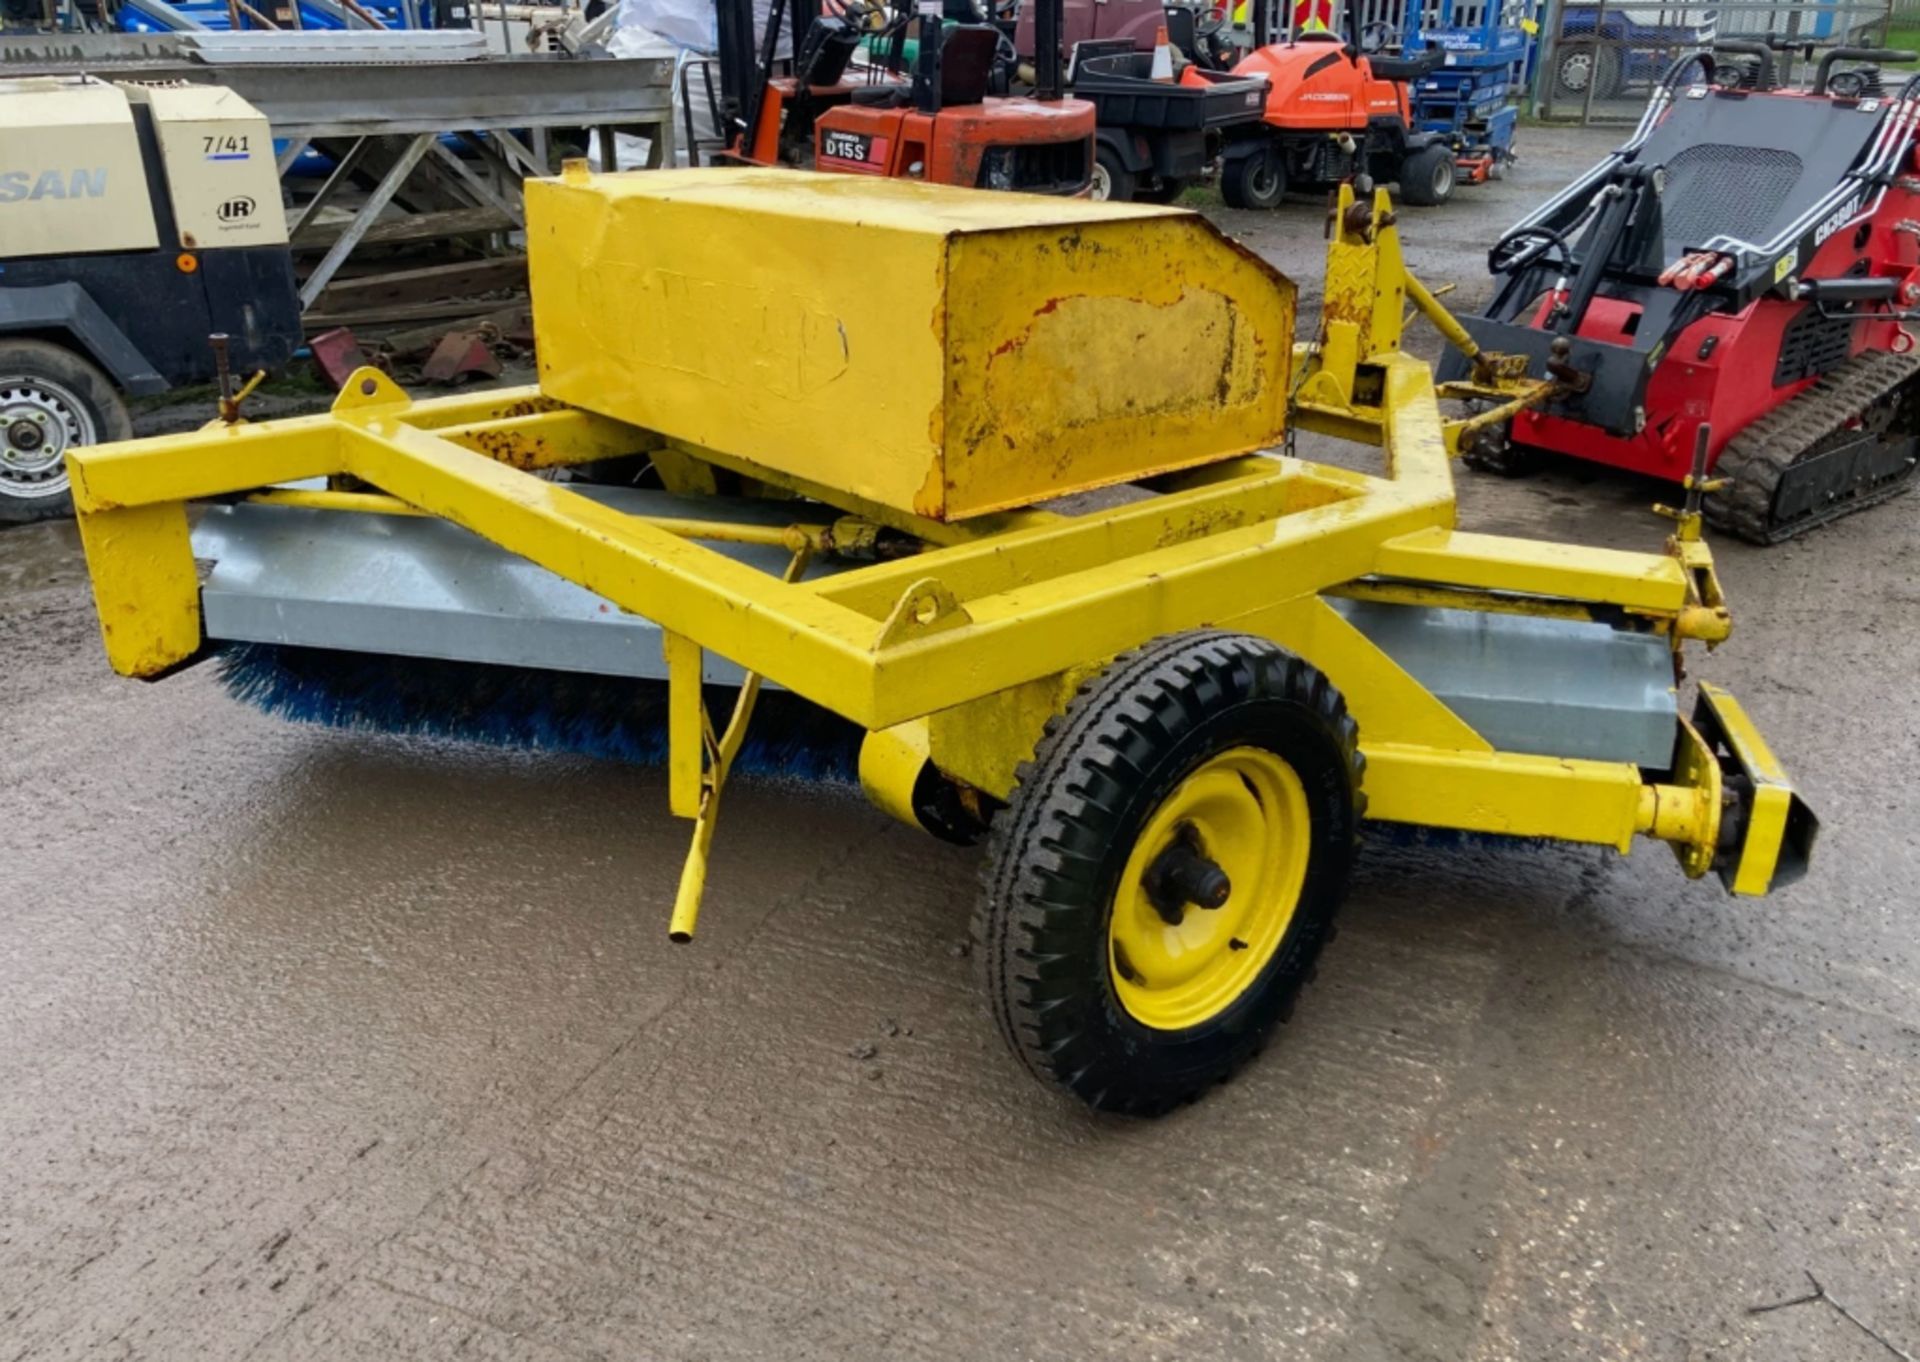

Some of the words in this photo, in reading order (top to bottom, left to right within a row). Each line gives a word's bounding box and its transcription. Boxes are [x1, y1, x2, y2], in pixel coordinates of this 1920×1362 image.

[203, 136, 249, 153] 7/41
[826, 140, 864, 160] D15S
[0, 168, 108, 203] SAN
[223, 200, 249, 218] IR
